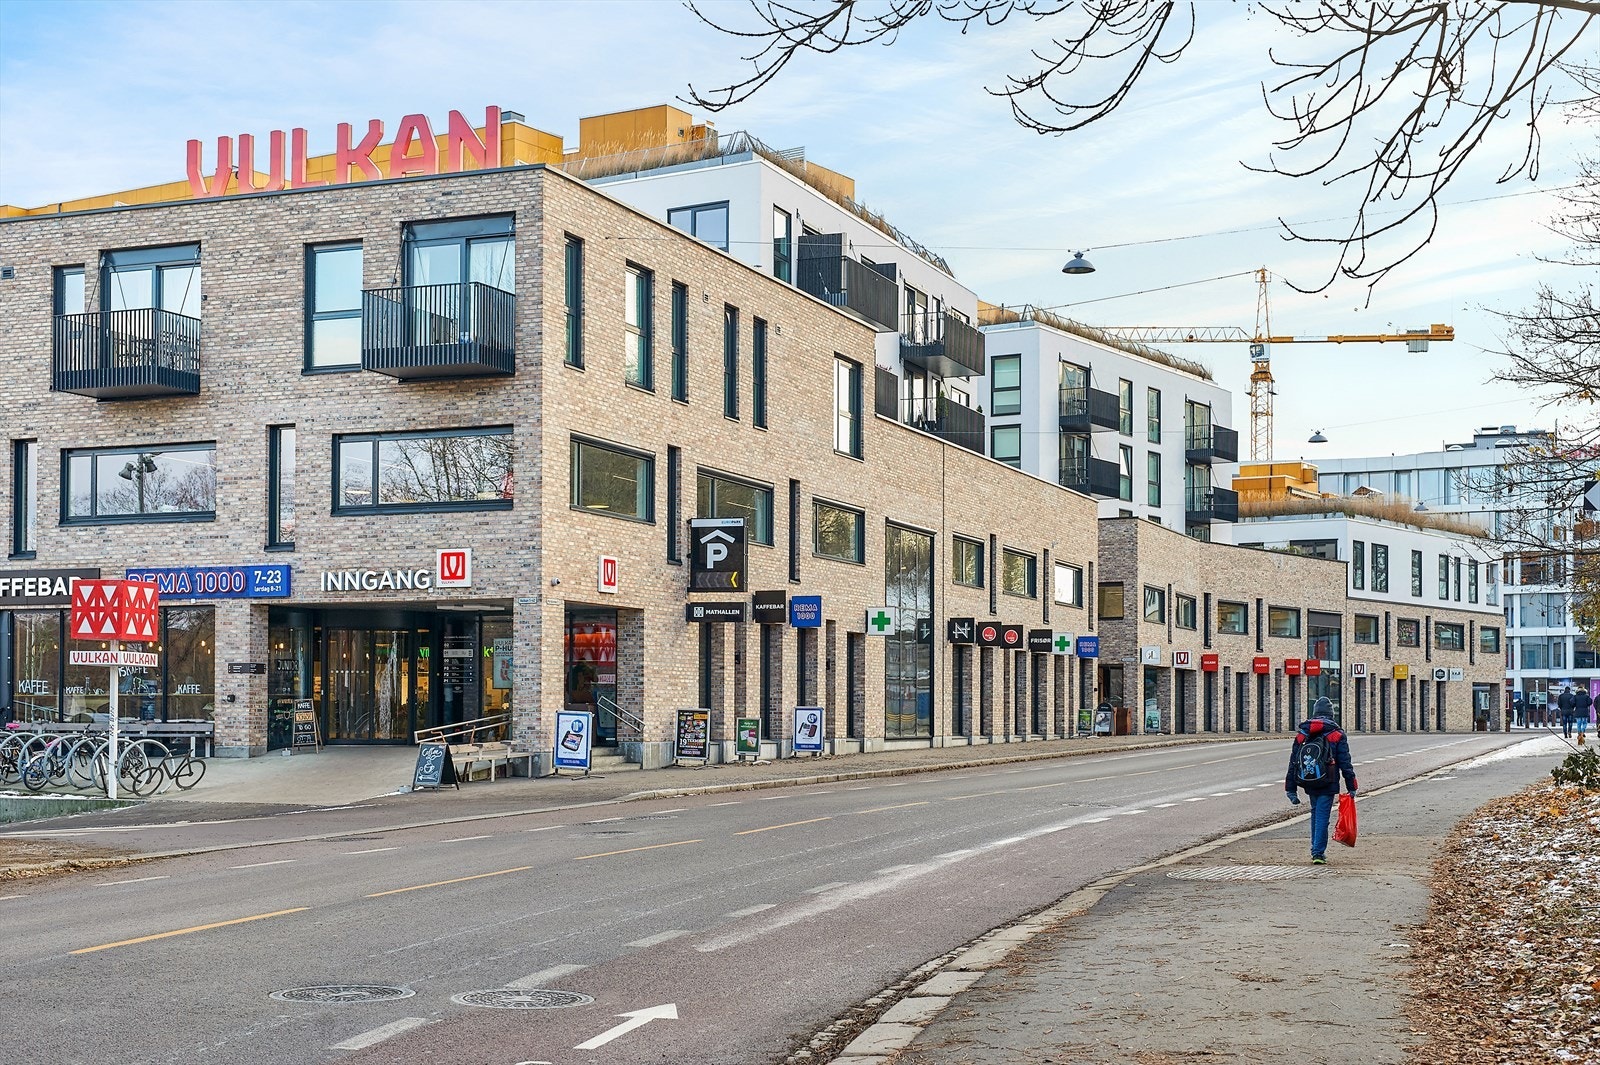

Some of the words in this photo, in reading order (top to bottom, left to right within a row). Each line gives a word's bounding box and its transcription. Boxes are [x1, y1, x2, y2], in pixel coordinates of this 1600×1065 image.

[186, 106, 501, 197] VULKAN
[706, 542, 728, 569] P
[195, 571, 245, 593] 1000
[254, 570, 281, 584] 7-23
[320, 569, 431, 592] INNGANG
[794, 604, 818, 612] REMA
[73, 652, 118, 664] VULKAN
[123, 653, 156, 665] VULKAN
[18, 680, 49, 694] KAFFE
[65, 686, 84, 694] KAFFE
[177, 684, 201, 694] KAFFE
